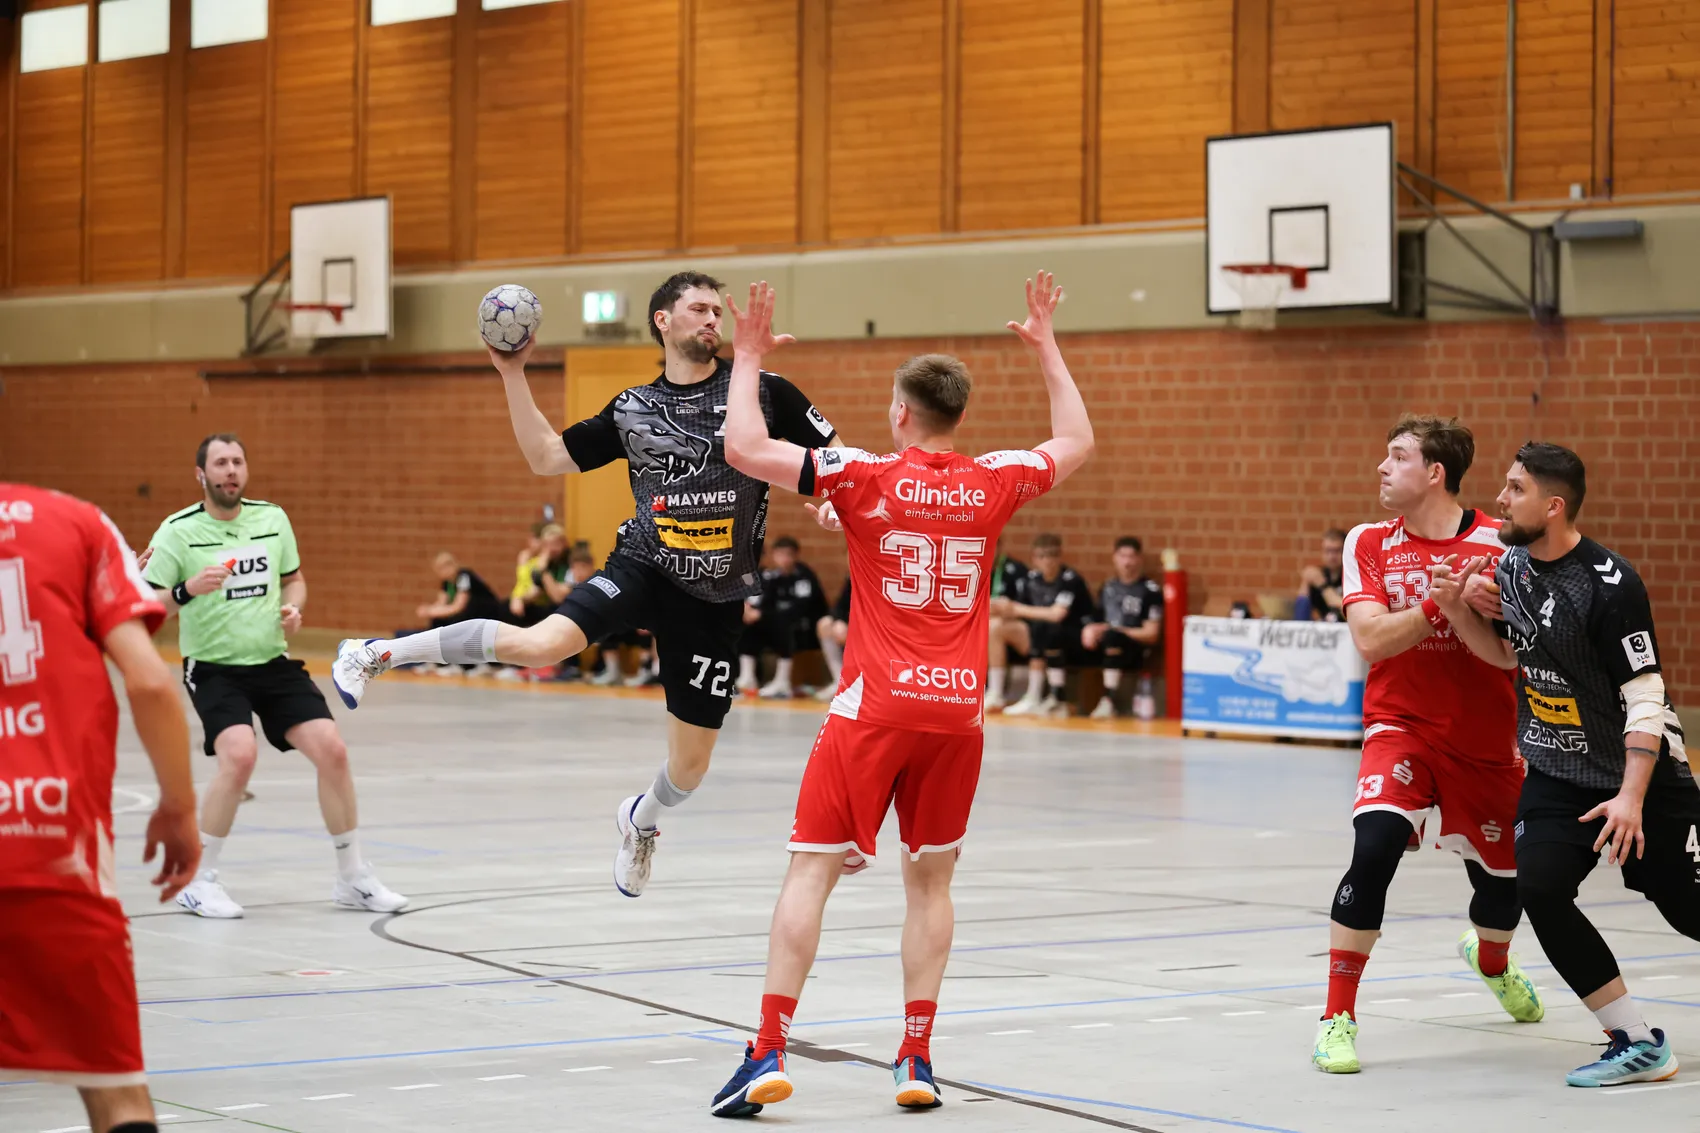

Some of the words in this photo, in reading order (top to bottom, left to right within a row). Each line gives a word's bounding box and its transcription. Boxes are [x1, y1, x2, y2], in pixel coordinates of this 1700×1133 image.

[667, 489, 737, 507] MAYWEG
[895, 478, 986, 507] Glinicke
[668, 504, 736, 516] KUNSTSTOFF-TECHNIK
[905, 507, 942, 521] einfach
[946, 511, 974, 522] mobil
[879, 529, 987, 613] 35
[1384, 570, 1430, 612] 53
[1539, 592, 1556, 628] 4
[688, 653, 731, 698] 72
[916, 663, 977, 691] sera
[890, 688, 977, 705] www.sera-web.com
